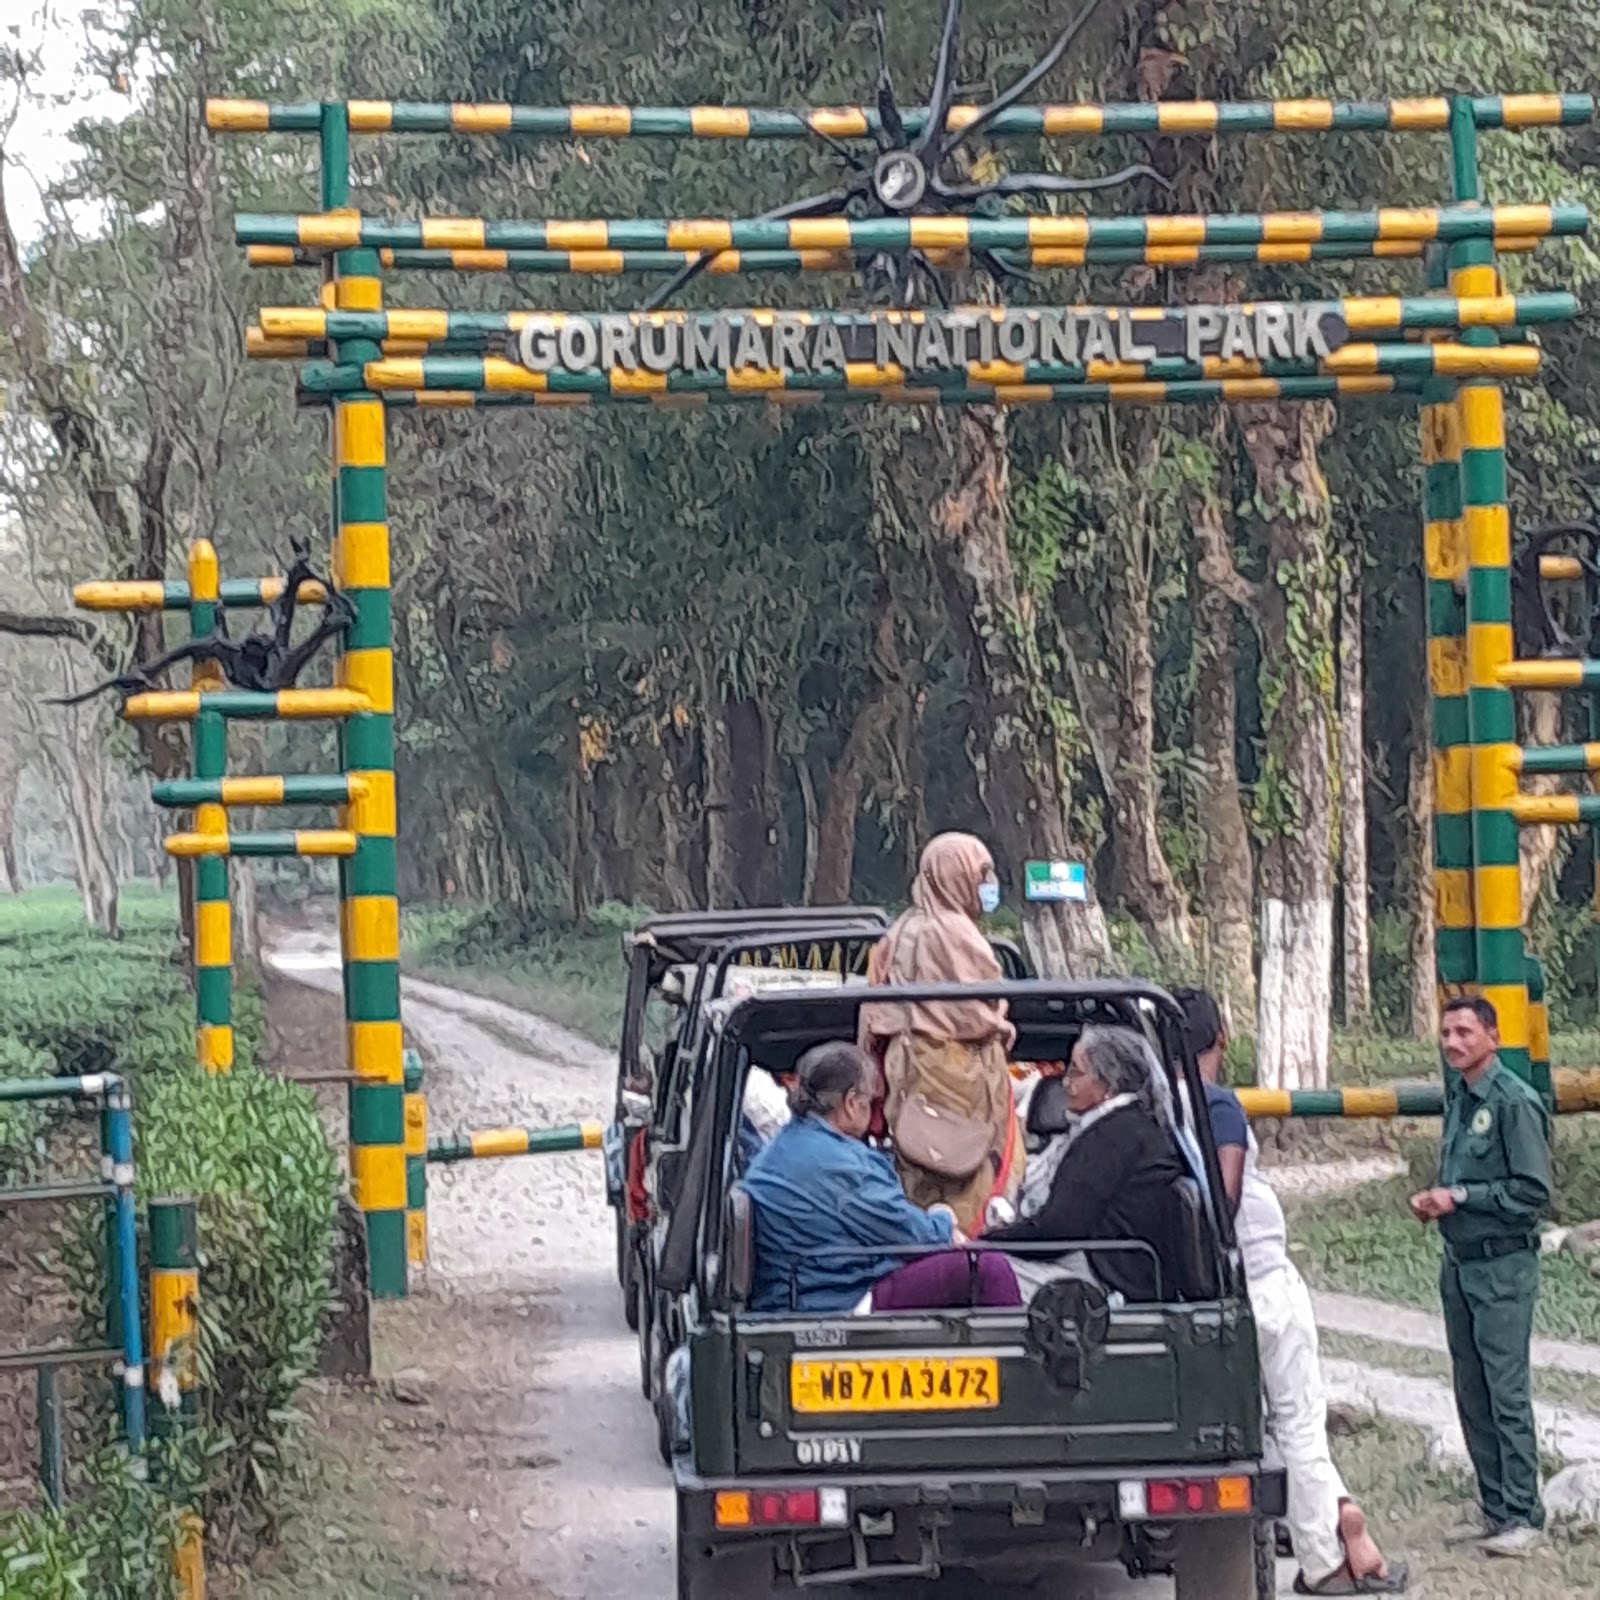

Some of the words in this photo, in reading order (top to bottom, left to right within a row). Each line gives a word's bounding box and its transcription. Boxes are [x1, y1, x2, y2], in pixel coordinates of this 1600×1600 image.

[518, 312, 848, 373] GORUMARA
[875, 309, 1157, 370] NATIONAL
[1185, 304, 1330, 360] PARK
